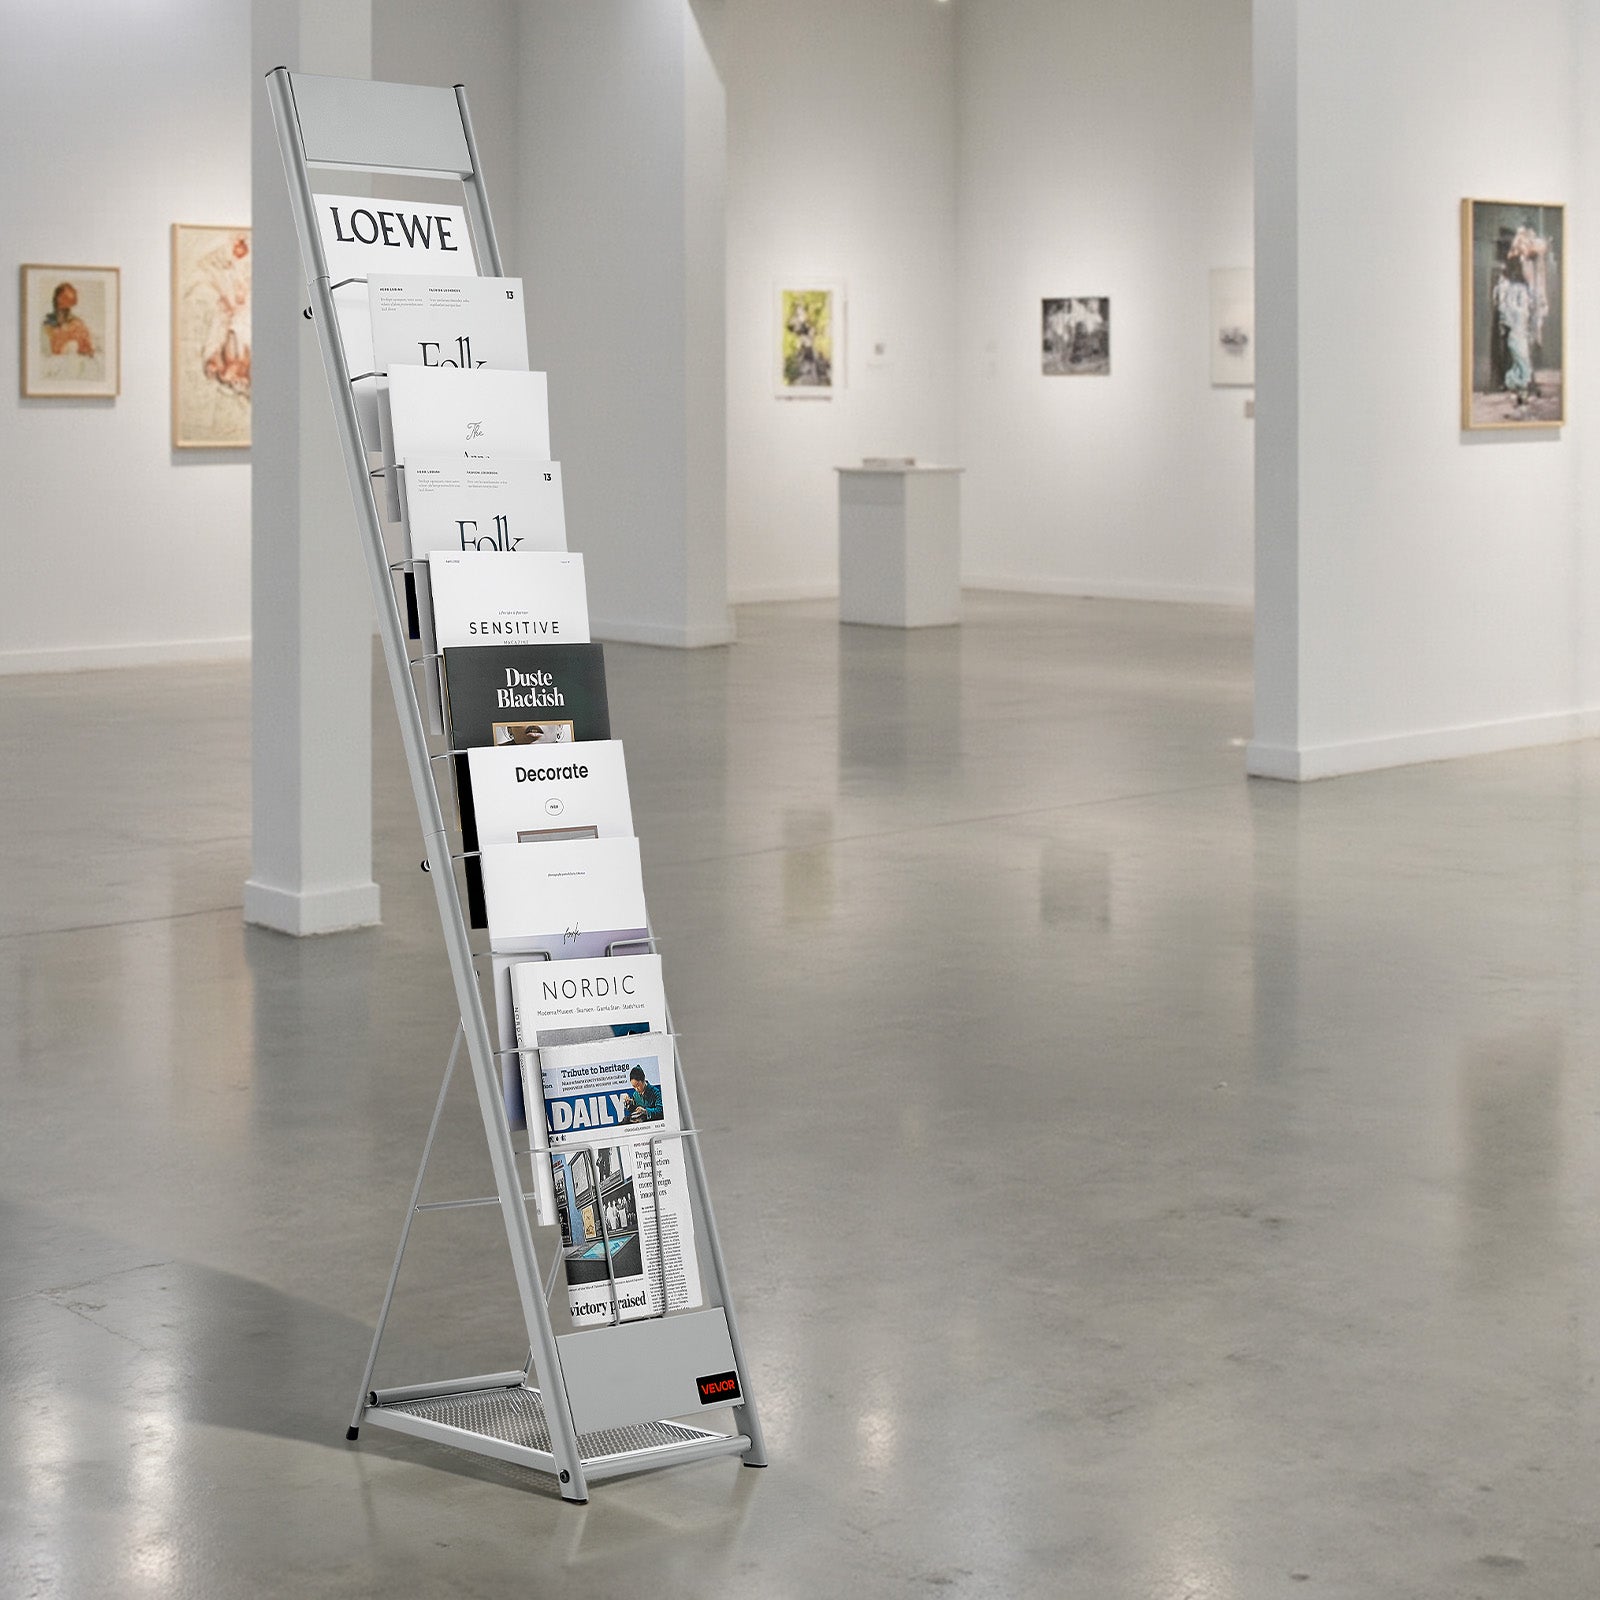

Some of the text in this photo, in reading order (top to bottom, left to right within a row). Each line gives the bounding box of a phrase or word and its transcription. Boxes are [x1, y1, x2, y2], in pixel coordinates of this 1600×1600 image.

[329, 206, 458, 251] LOEWE
[505, 290, 514, 300] 13
[465, 421, 484, 441] The
[543, 473, 552, 481] 13
[455, 514, 525, 551] Folk
[469, 621, 560, 634] SENSITIVE
[505, 667, 553, 687] Duste
[496, 687, 565, 708] Blackish
[515, 763, 589, 783] Decorate
[542, 975, 635, 1000] NORDIC
[561, 1067, 590, 1079] Tribute
[590, 1067, 598, 1075] to
[598, 1063, 630, 1075] heritage
[551, 1092, 630, 1132] DAILY
[643, 1158, 670, 1170] proction
[570, 1290, 647, 1317] victory praised
[701, 1379, 735, 1395] VEVOR
